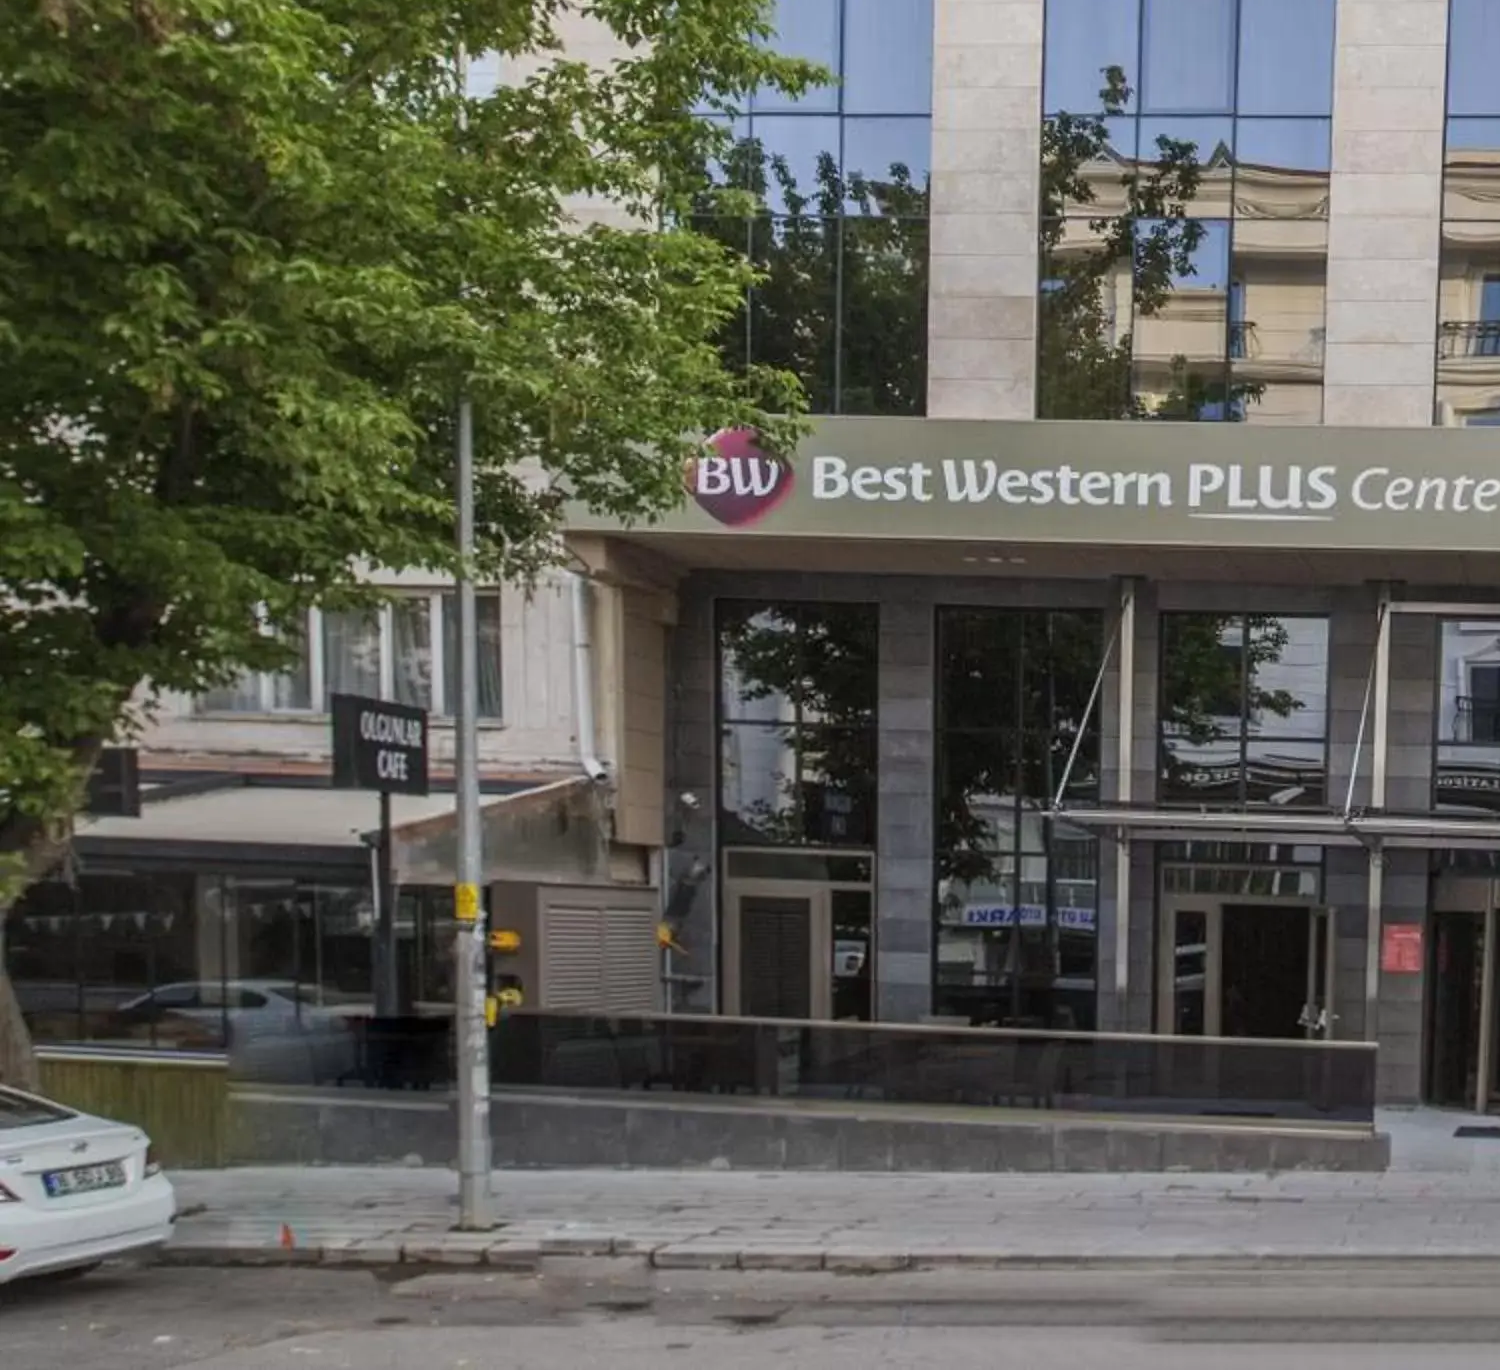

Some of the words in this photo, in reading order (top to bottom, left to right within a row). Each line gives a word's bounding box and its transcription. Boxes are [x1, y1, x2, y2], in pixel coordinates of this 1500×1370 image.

[697, 456, 780, 497] BW
[812, 455, 932, 502] Best
[942, 460, 1172, 507] Western
[1188, 463, 1338, 510] PLUS
[377, 749, 409, 781] CAFE
